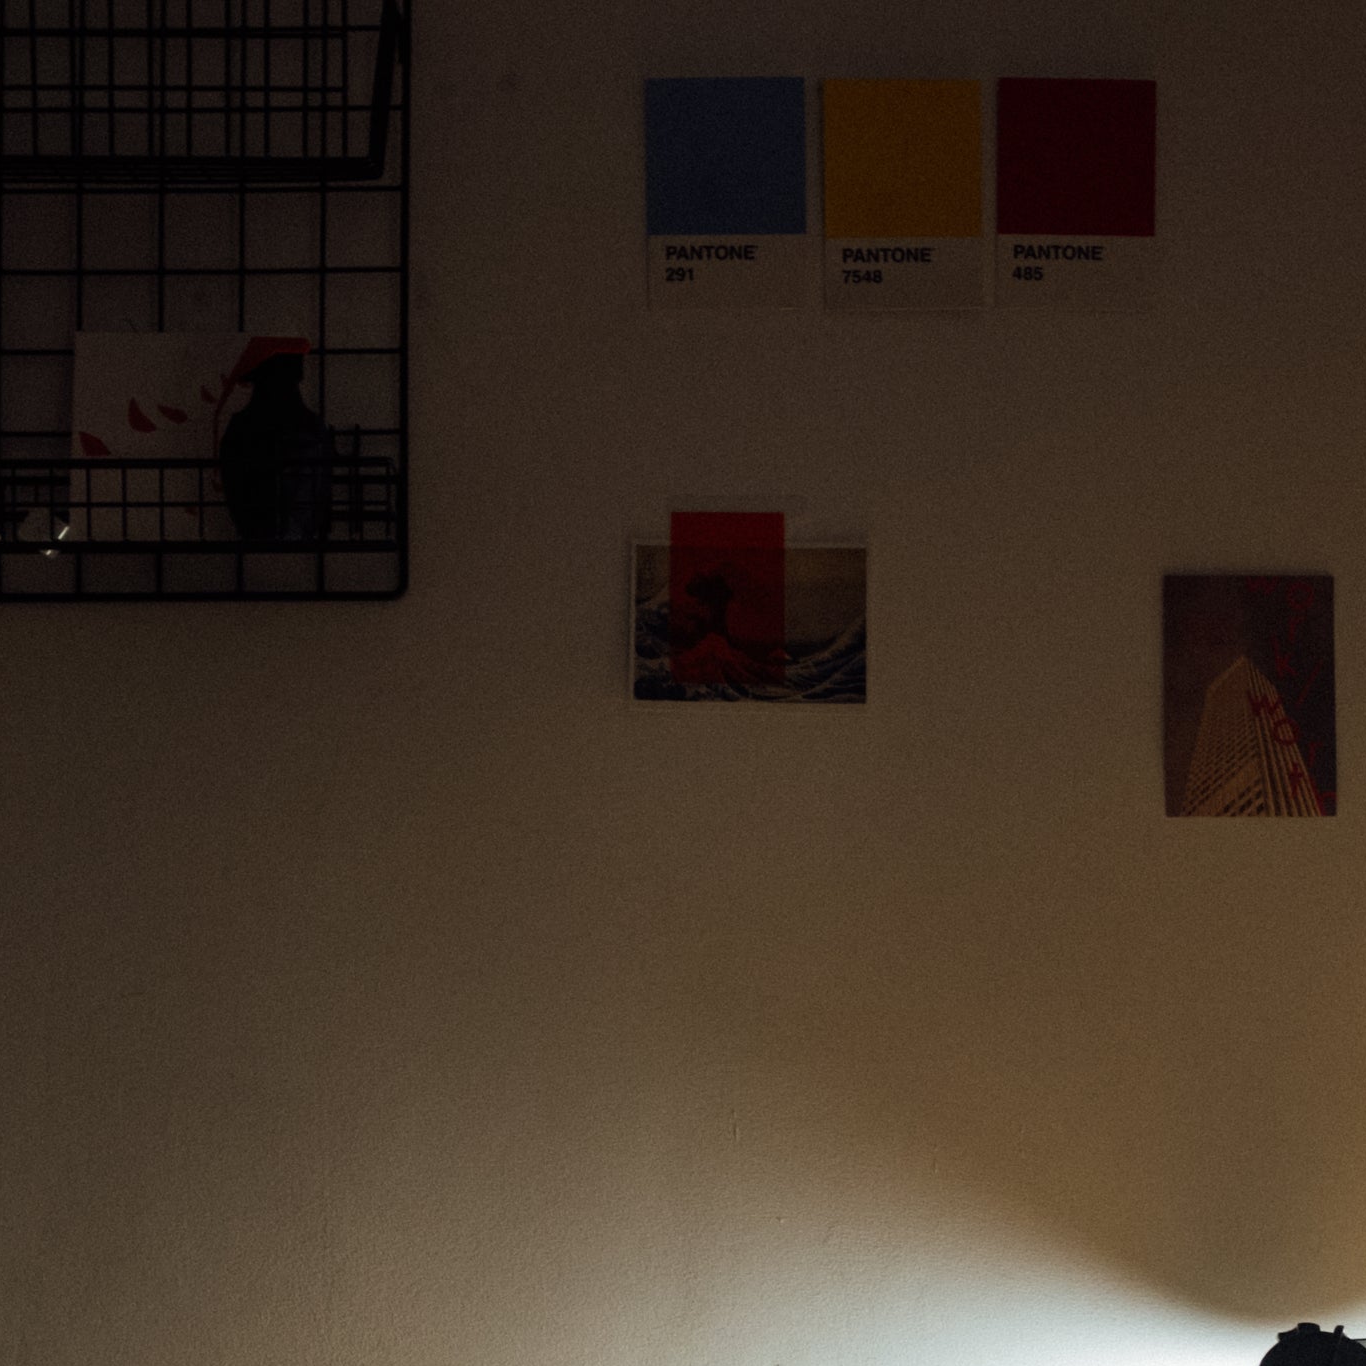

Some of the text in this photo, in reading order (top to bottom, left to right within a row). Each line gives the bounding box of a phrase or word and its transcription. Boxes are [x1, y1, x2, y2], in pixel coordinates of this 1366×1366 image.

[665, 245, 755, 261] PANTONE
[842, 248, 932, 263] PANTONE
[1013, 245, 1103, 261] PANTONE
[665, 267, 695, 282] 291
[842, 269, 883, 284] 7548
[1012, 266, 1044, 281] 485
